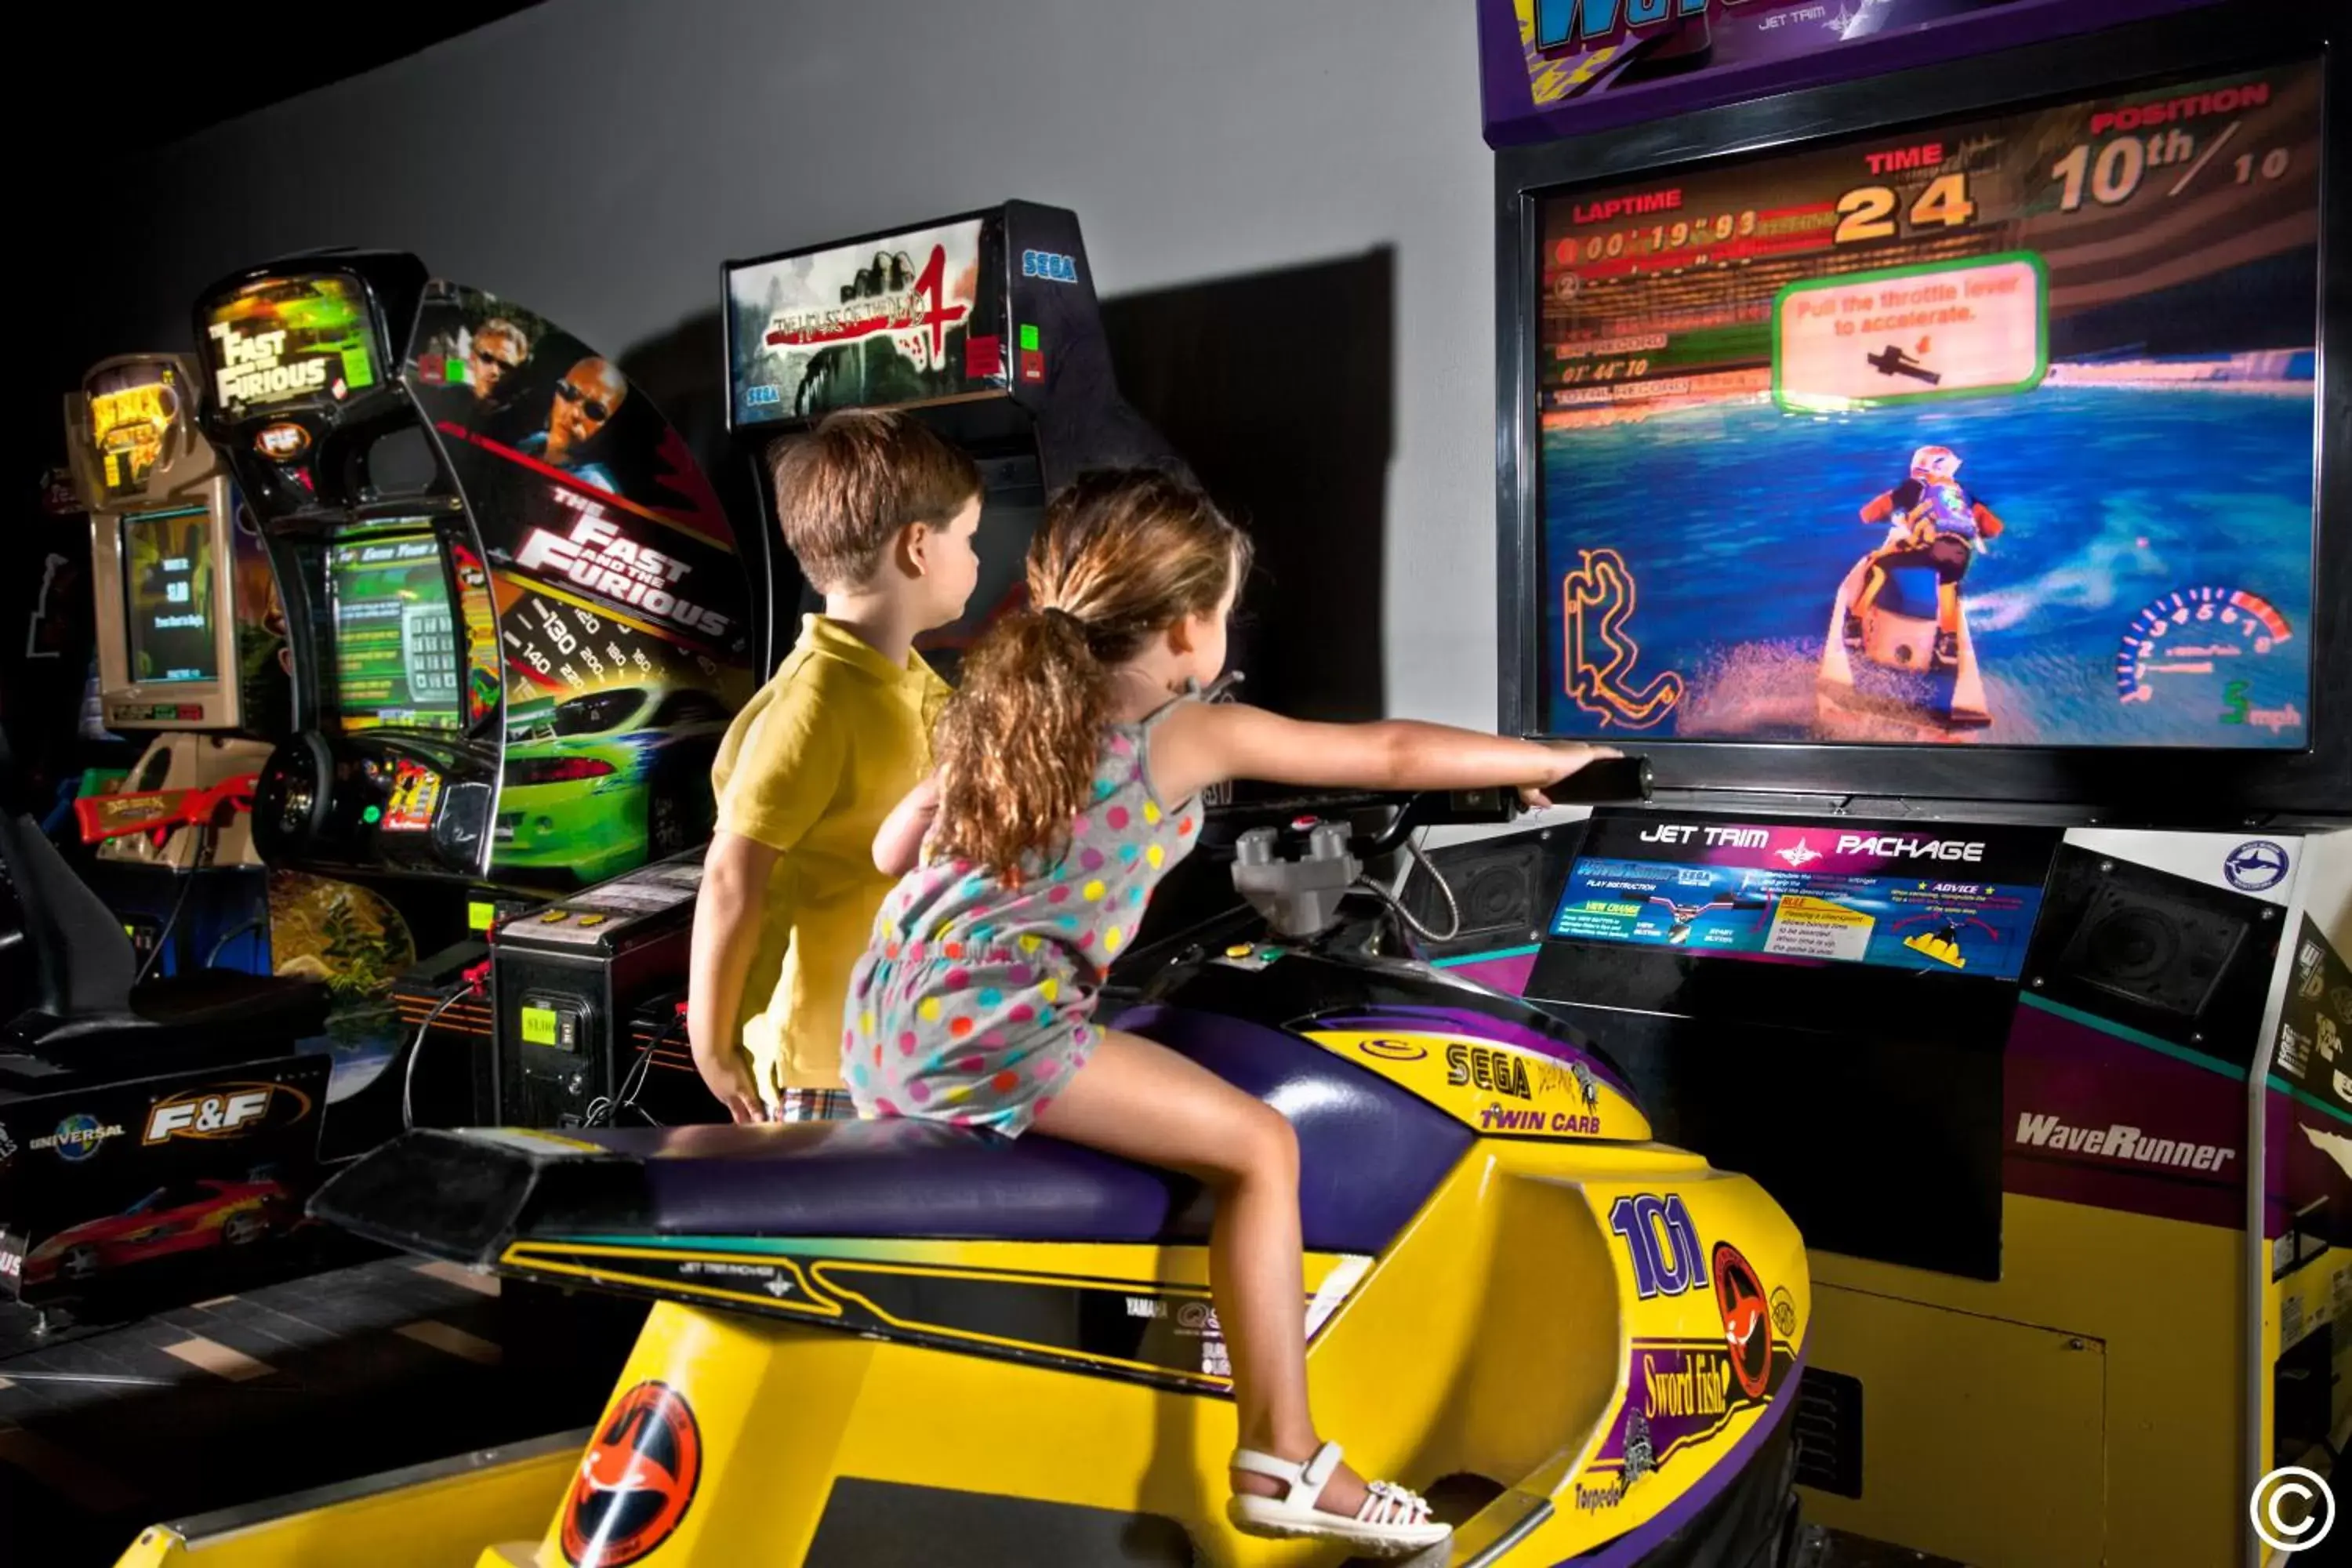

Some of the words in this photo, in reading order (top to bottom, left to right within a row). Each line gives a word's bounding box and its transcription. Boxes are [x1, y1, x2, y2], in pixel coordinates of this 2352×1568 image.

[1759, 13, 1788, 31] JET
[1790, 5, 1826, 23] TRIM
[2090, 82, 2270, 135] POSITION
[1866, 143, 1943, 175] TIME
[2052, 128, 2194, 212] 10th
[1573, 189, 1683, 224] LAPTIME
[1833, 172, 1976, 245] 24
[1023, 249, 1078, 283] SEGA
[1797, 300, 1836, 319] Pull
[1842, 294, 1873, 312] the
[1880, 284, 1958, 307] throttle
[1963, 276, 2020, 297] lever
[1833, 319, 1855, 336] to
[1861, 306, 1976, 333] accelerate.
[222, 330, 287, 367] FAST
[216, 358, 326, 408] FURIOUS
[746, 385, 780, 406] SEGA
[552, 486, 606, 517] THE
[568, 514, 692, 583] FAST
[516, 527, 730, 637] FURIOUS
[581, 548, 624, 576] AND
[624, 564, 666, 588] THE
[543, 611, 577, 655] 130
[522, 641, 552, 675] 140
[579, 646, 604, 676] 200
[559, 662, 585, 691] 220
[1639, 824, 1700, 844] JET
[1704, 826, 1770, 849] TRIM
[1585, 879, 1607, 889] PLAY
[1932, 882, 1980, 895] ADVICE
[1446, 1043, 1533, 1100] SEGA
[147, 1091, 269, 1142] F&F
[1480, 1106, 1547, 1131] TWIN
[1551, 1112, 1601, 1135] CARB
[29, 1123, 126, 1151] UNIVERSAL
[2015, 1112, 2236, 1172] WaveRunner
[1607, 1191, 1709, 1301] 101
[1125, 1297, 1168, 1319] YAMAHA
[1642, 1353, 1693, 1420] Sword
[1574, 1479, 1624, 1519] Torpedo
